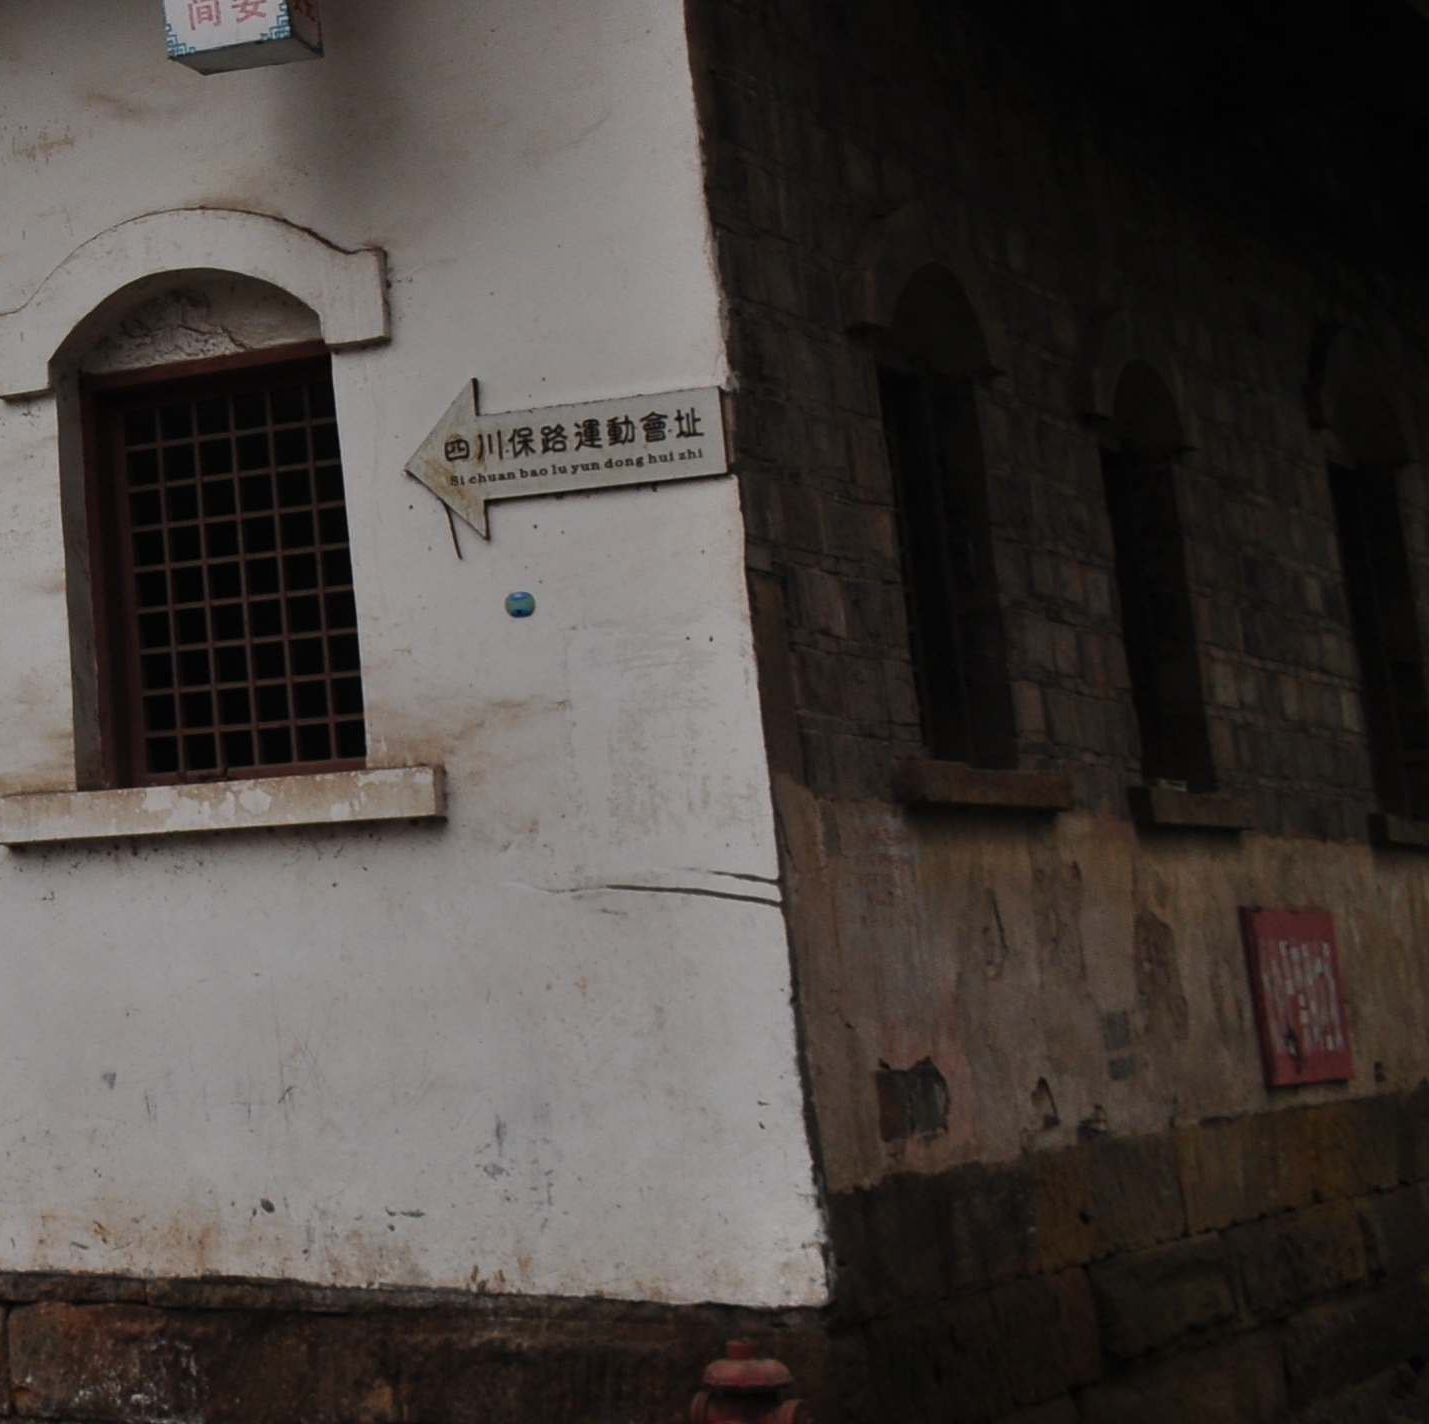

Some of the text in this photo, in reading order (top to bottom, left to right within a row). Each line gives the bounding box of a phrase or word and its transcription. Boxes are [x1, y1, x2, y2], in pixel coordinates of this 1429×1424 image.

[444, 407, 705, 463] 四川保路運動會址
[449, 447, 704, 487] Si chuan bao lu yun dong hui zhi
